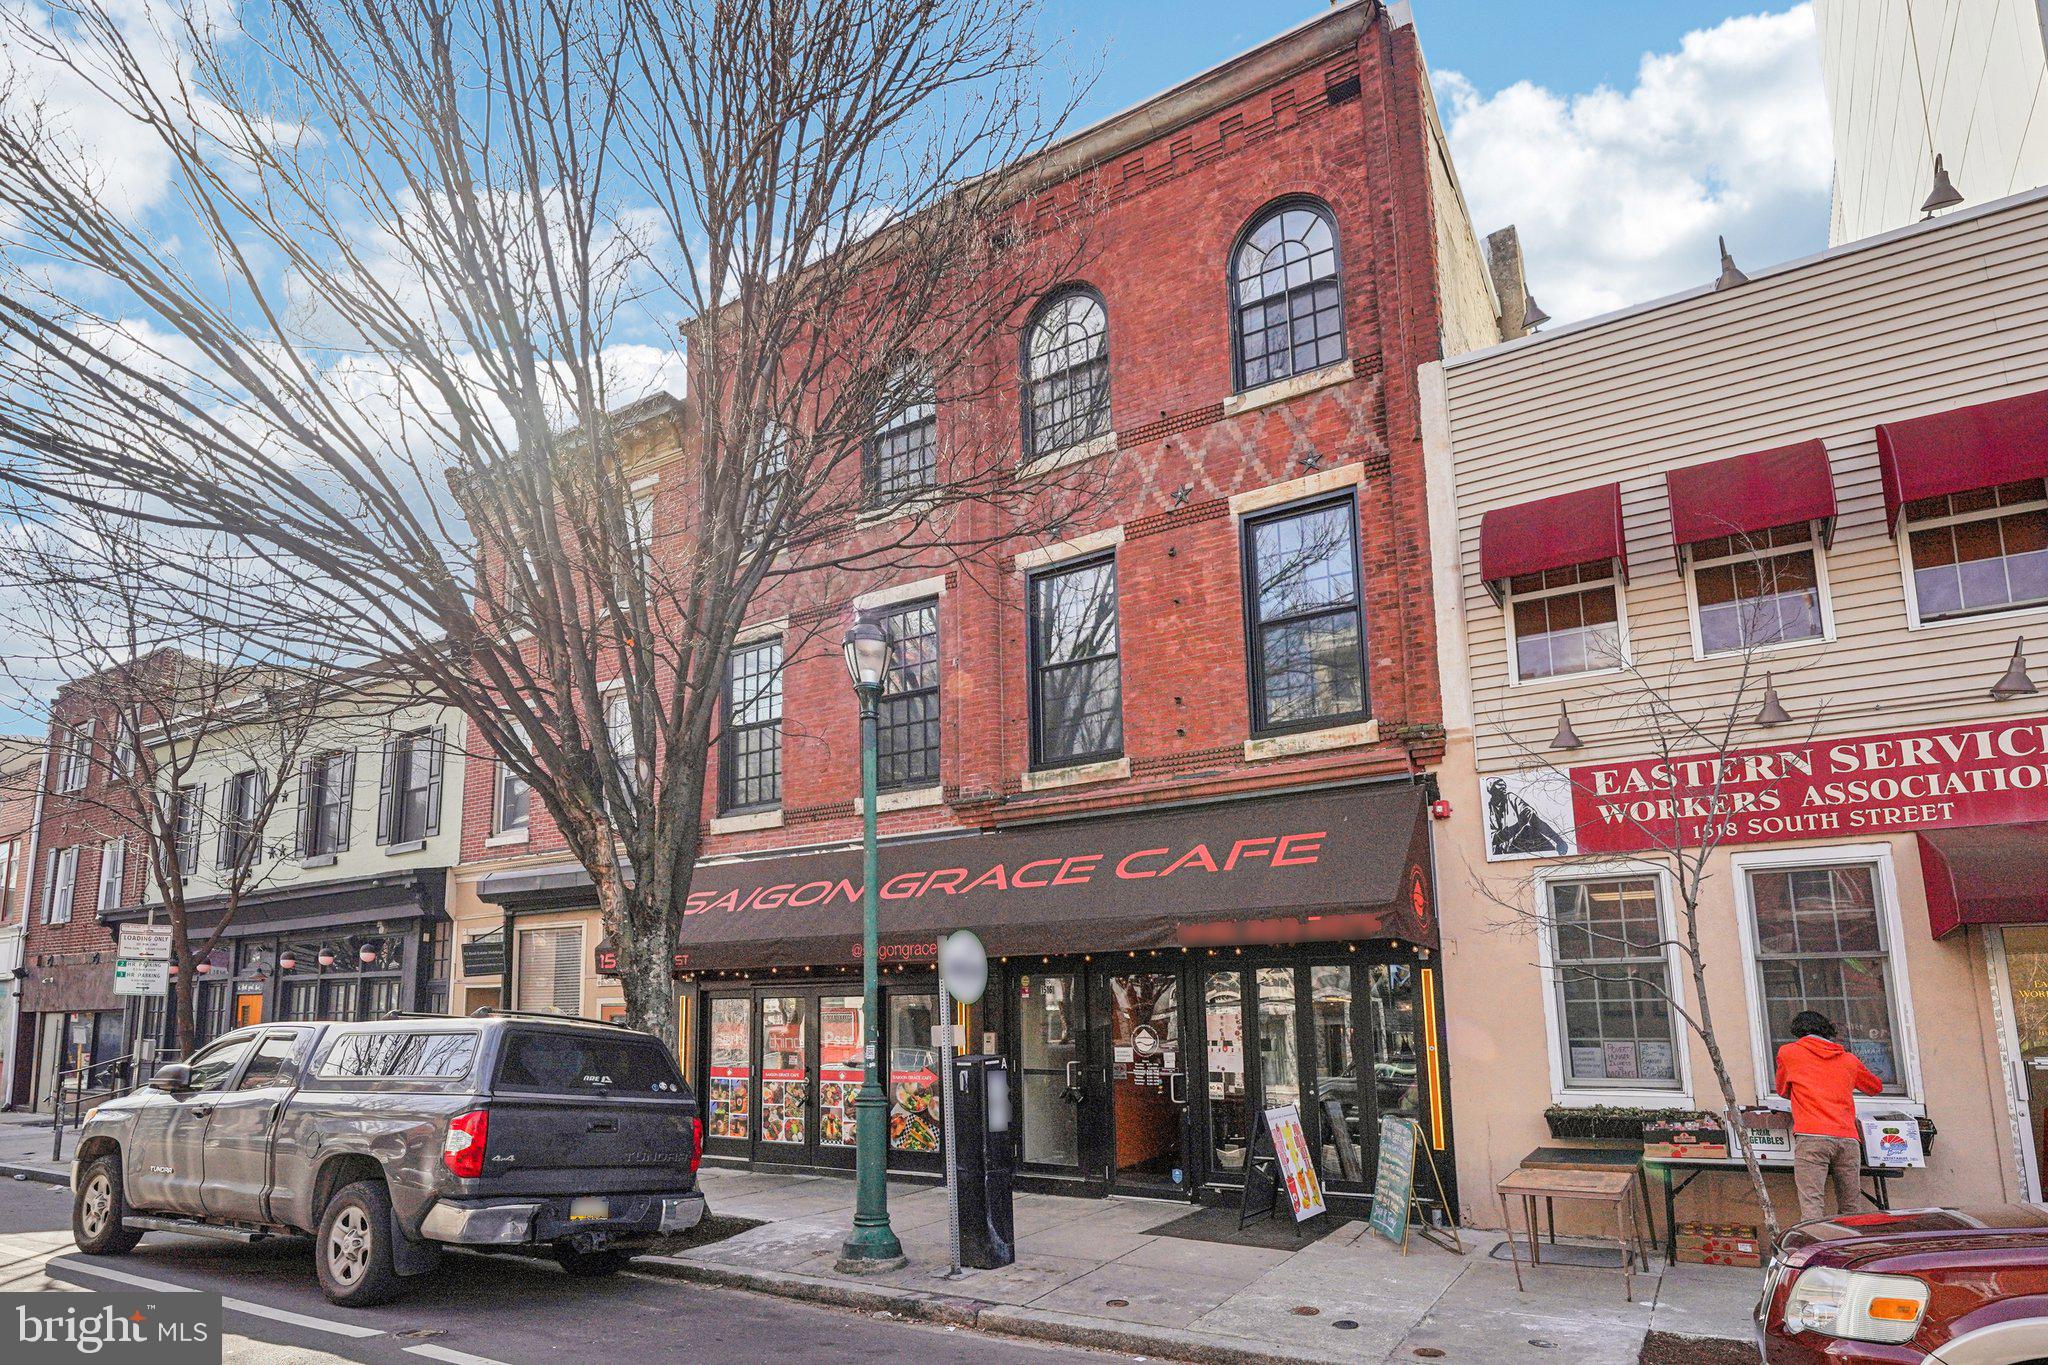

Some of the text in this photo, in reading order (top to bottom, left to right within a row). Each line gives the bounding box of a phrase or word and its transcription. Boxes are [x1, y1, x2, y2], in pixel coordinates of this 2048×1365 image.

[1590, 749, 1814, 797] EASTERN
[1596, 789, 1781, 825] WORKERS
[1693, 802, 1955, 839] 1518 SOUTH STREET
[684, 831, 1327, 915] SAIGON GRACE CAFE
[600, 953, 690, 968] 15 ST
[851, 942, 938, 961] @gongrace
[1001, 1057, 1008, 1070] A
[1749, 1136, 1785, 1146] GETABLES
